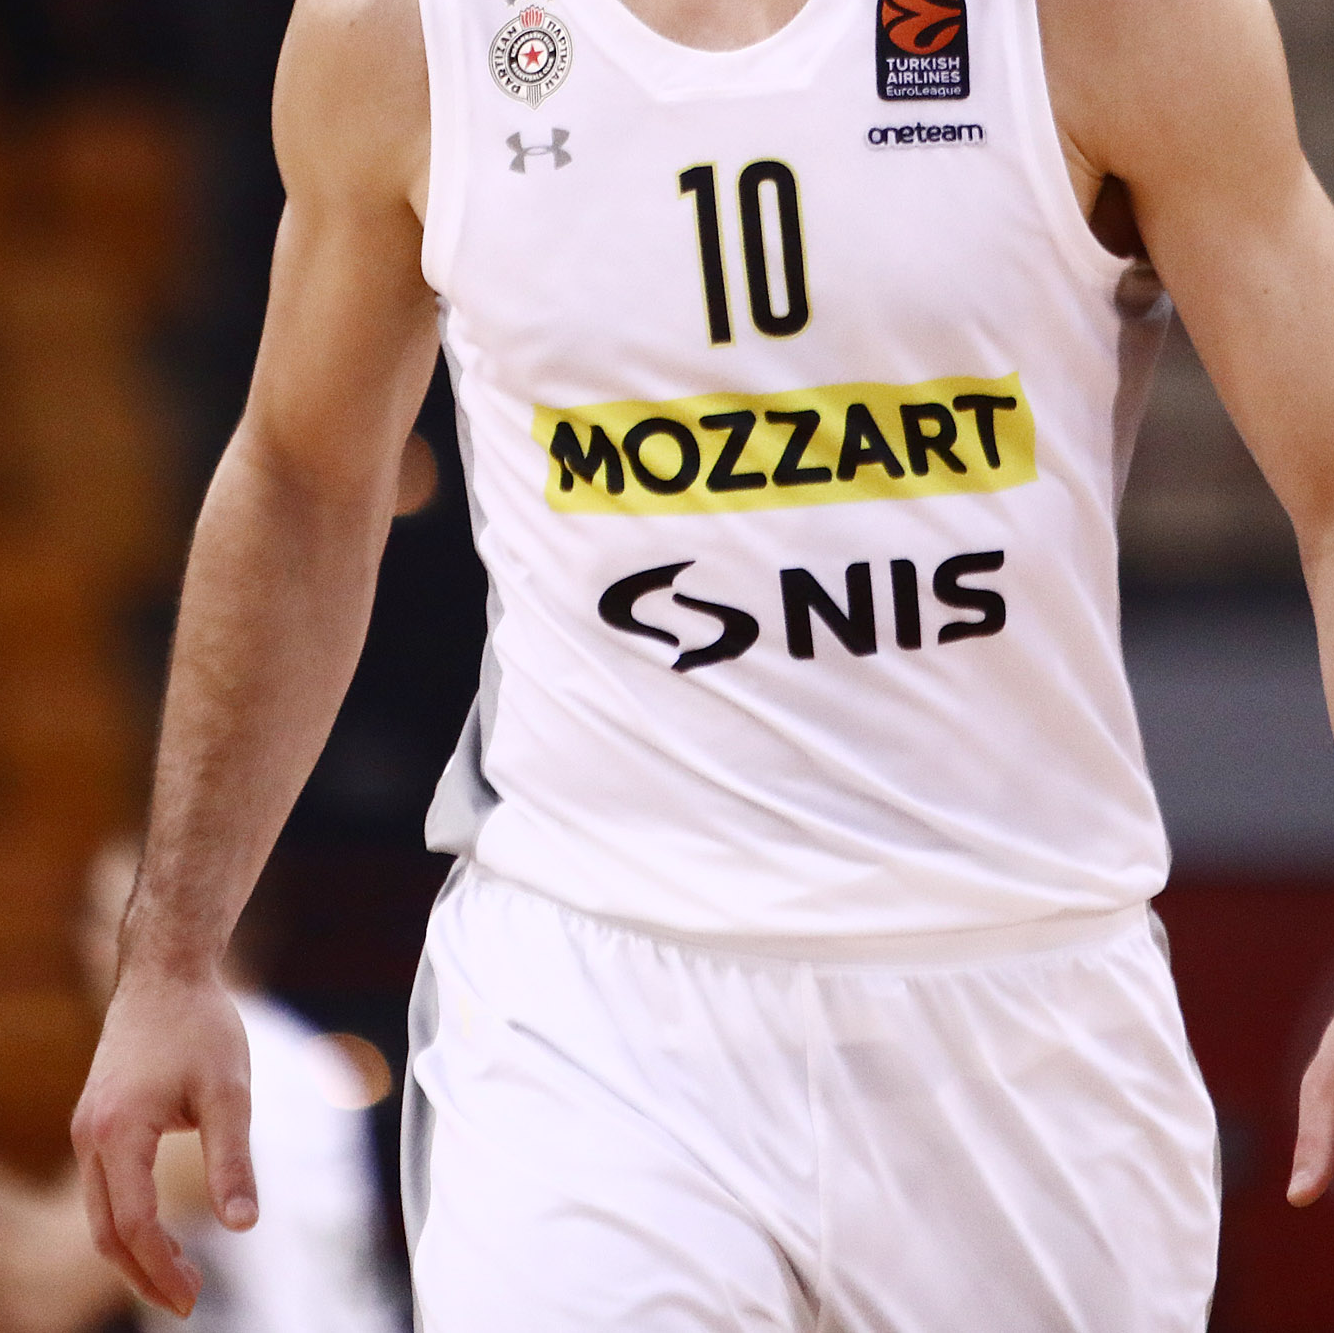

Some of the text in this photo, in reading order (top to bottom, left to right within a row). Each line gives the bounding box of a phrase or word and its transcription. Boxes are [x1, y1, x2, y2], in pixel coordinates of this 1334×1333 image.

[494, 25, 522, 95] PARTIZAN
[546, 20, 569, 90] ПАРТИЗАН
[886, 56, 960, 71] TURKISH
[886, 71, 961, 85] AIRLINES
[886, 85, 962, 97] EuroLeague
[867, 122, 984, 145] oneteam
[676, 157, 812, 349] 10
[549, 393, 1018, 496] MOZZART
[778, 549, 1007, 661] NIS
